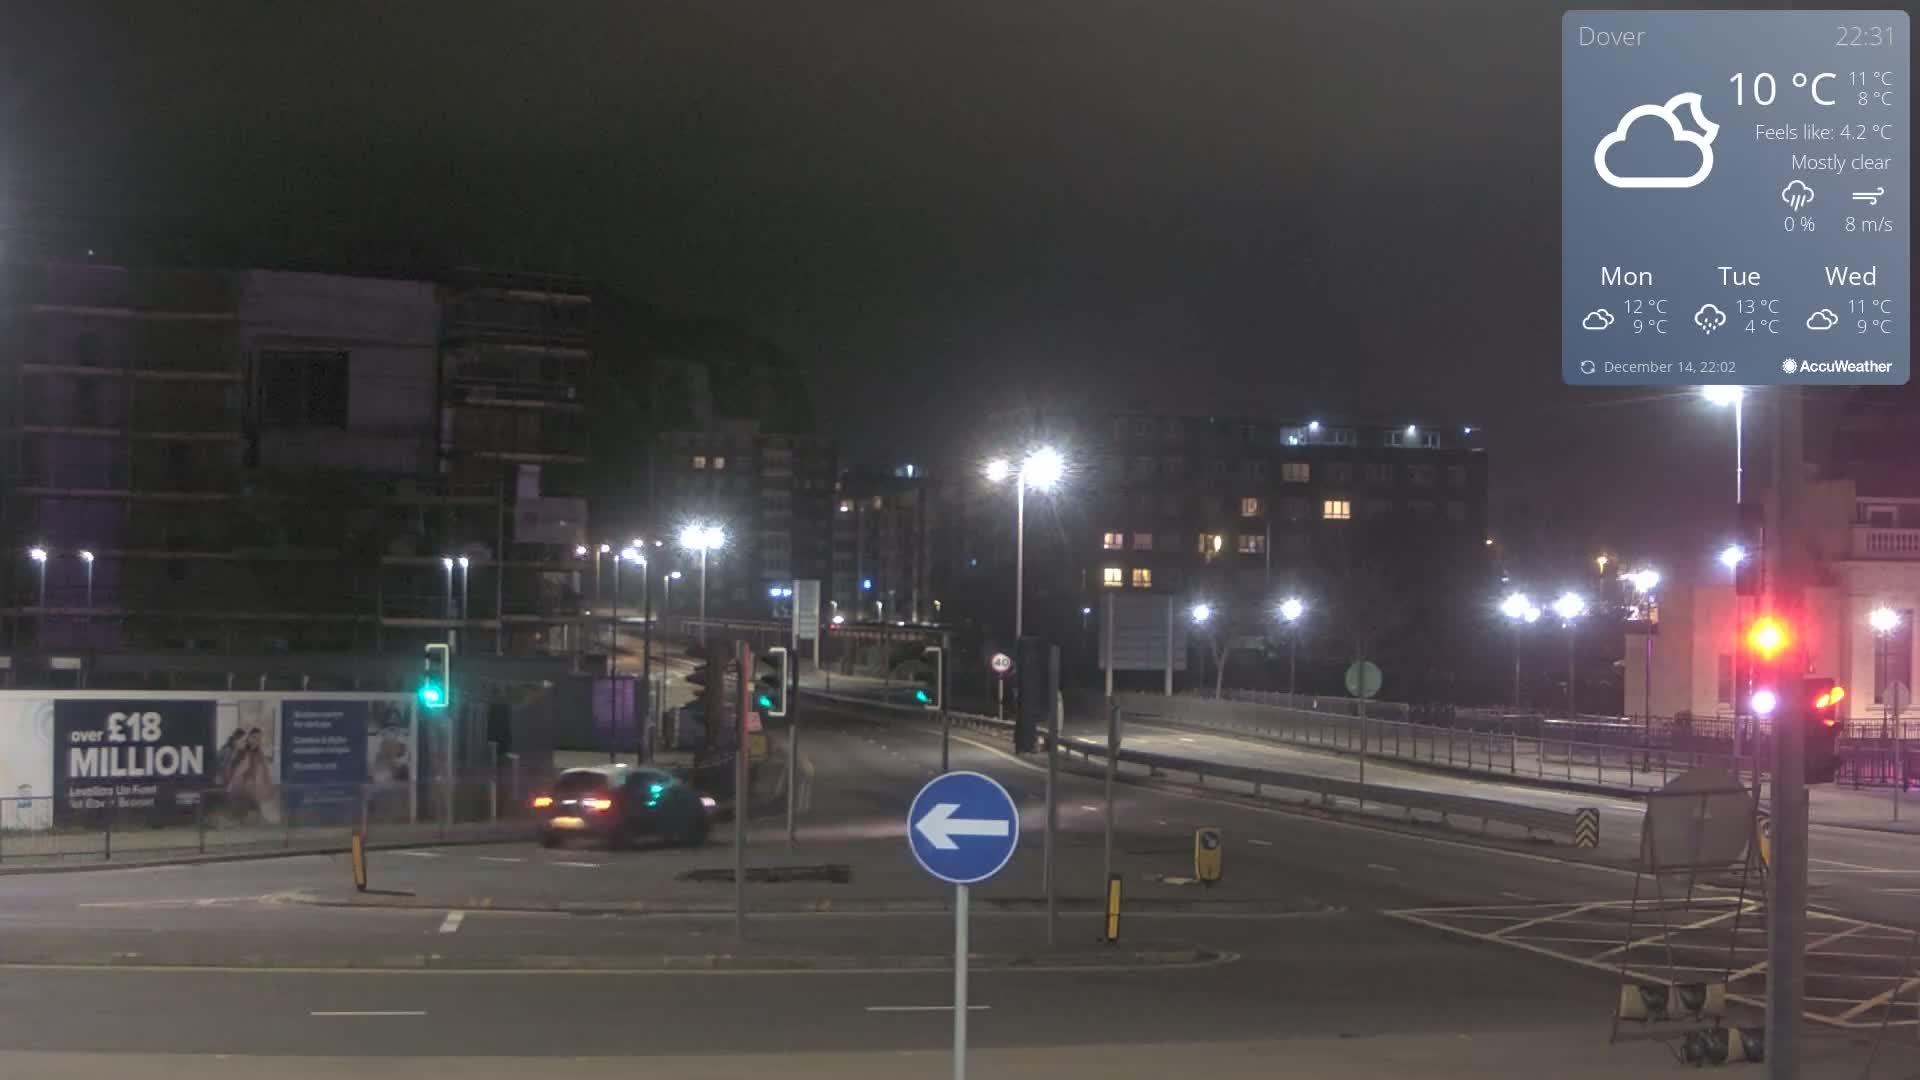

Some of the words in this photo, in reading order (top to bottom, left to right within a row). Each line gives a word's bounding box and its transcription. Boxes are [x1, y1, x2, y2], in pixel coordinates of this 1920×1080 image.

[71, 730, 103, 742] over
[107, 711, 162, 741] £18
[70, 745, 204, 777] MILLION
